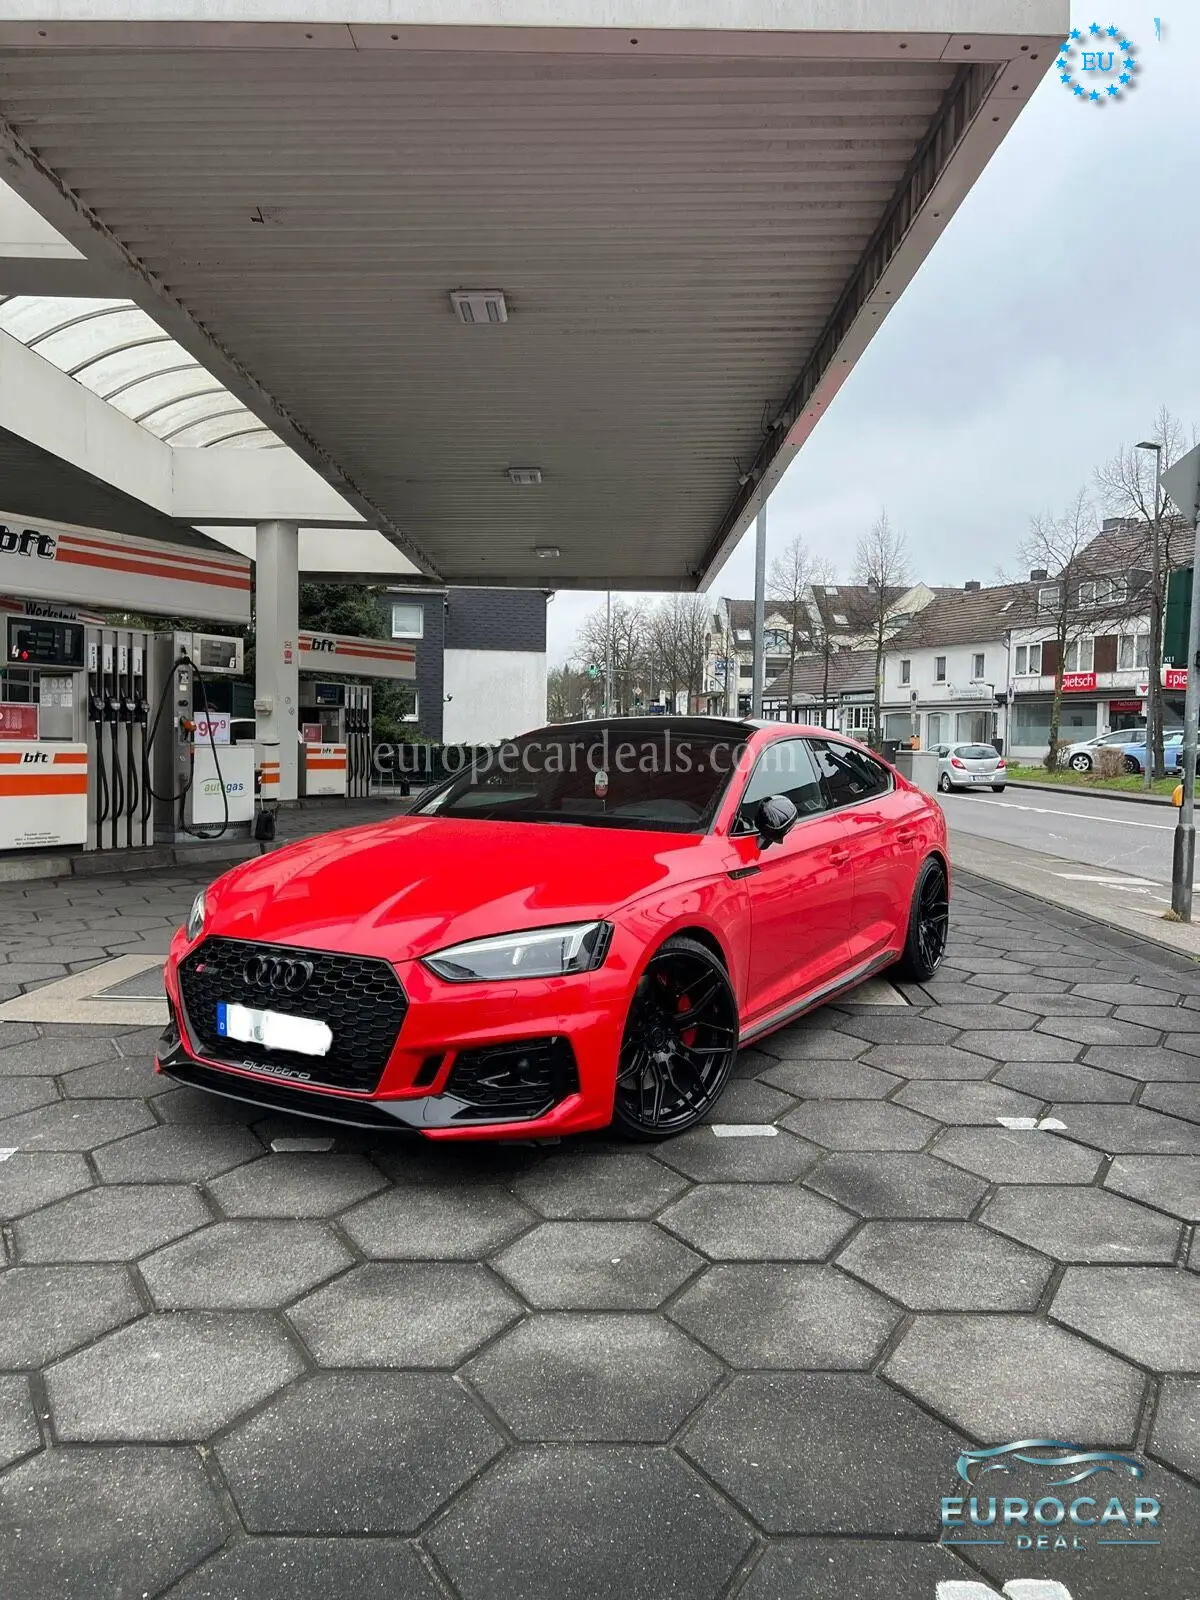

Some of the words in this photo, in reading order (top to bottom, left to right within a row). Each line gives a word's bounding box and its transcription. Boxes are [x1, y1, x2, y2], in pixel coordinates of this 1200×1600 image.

[0, 525, 56, 559] bft
[311, 638, 334, 652] bft
[229, 657, 236, 668] 6
[23, 752, 48, 763] bft
[243, 1060, 311, 1080] quattro
